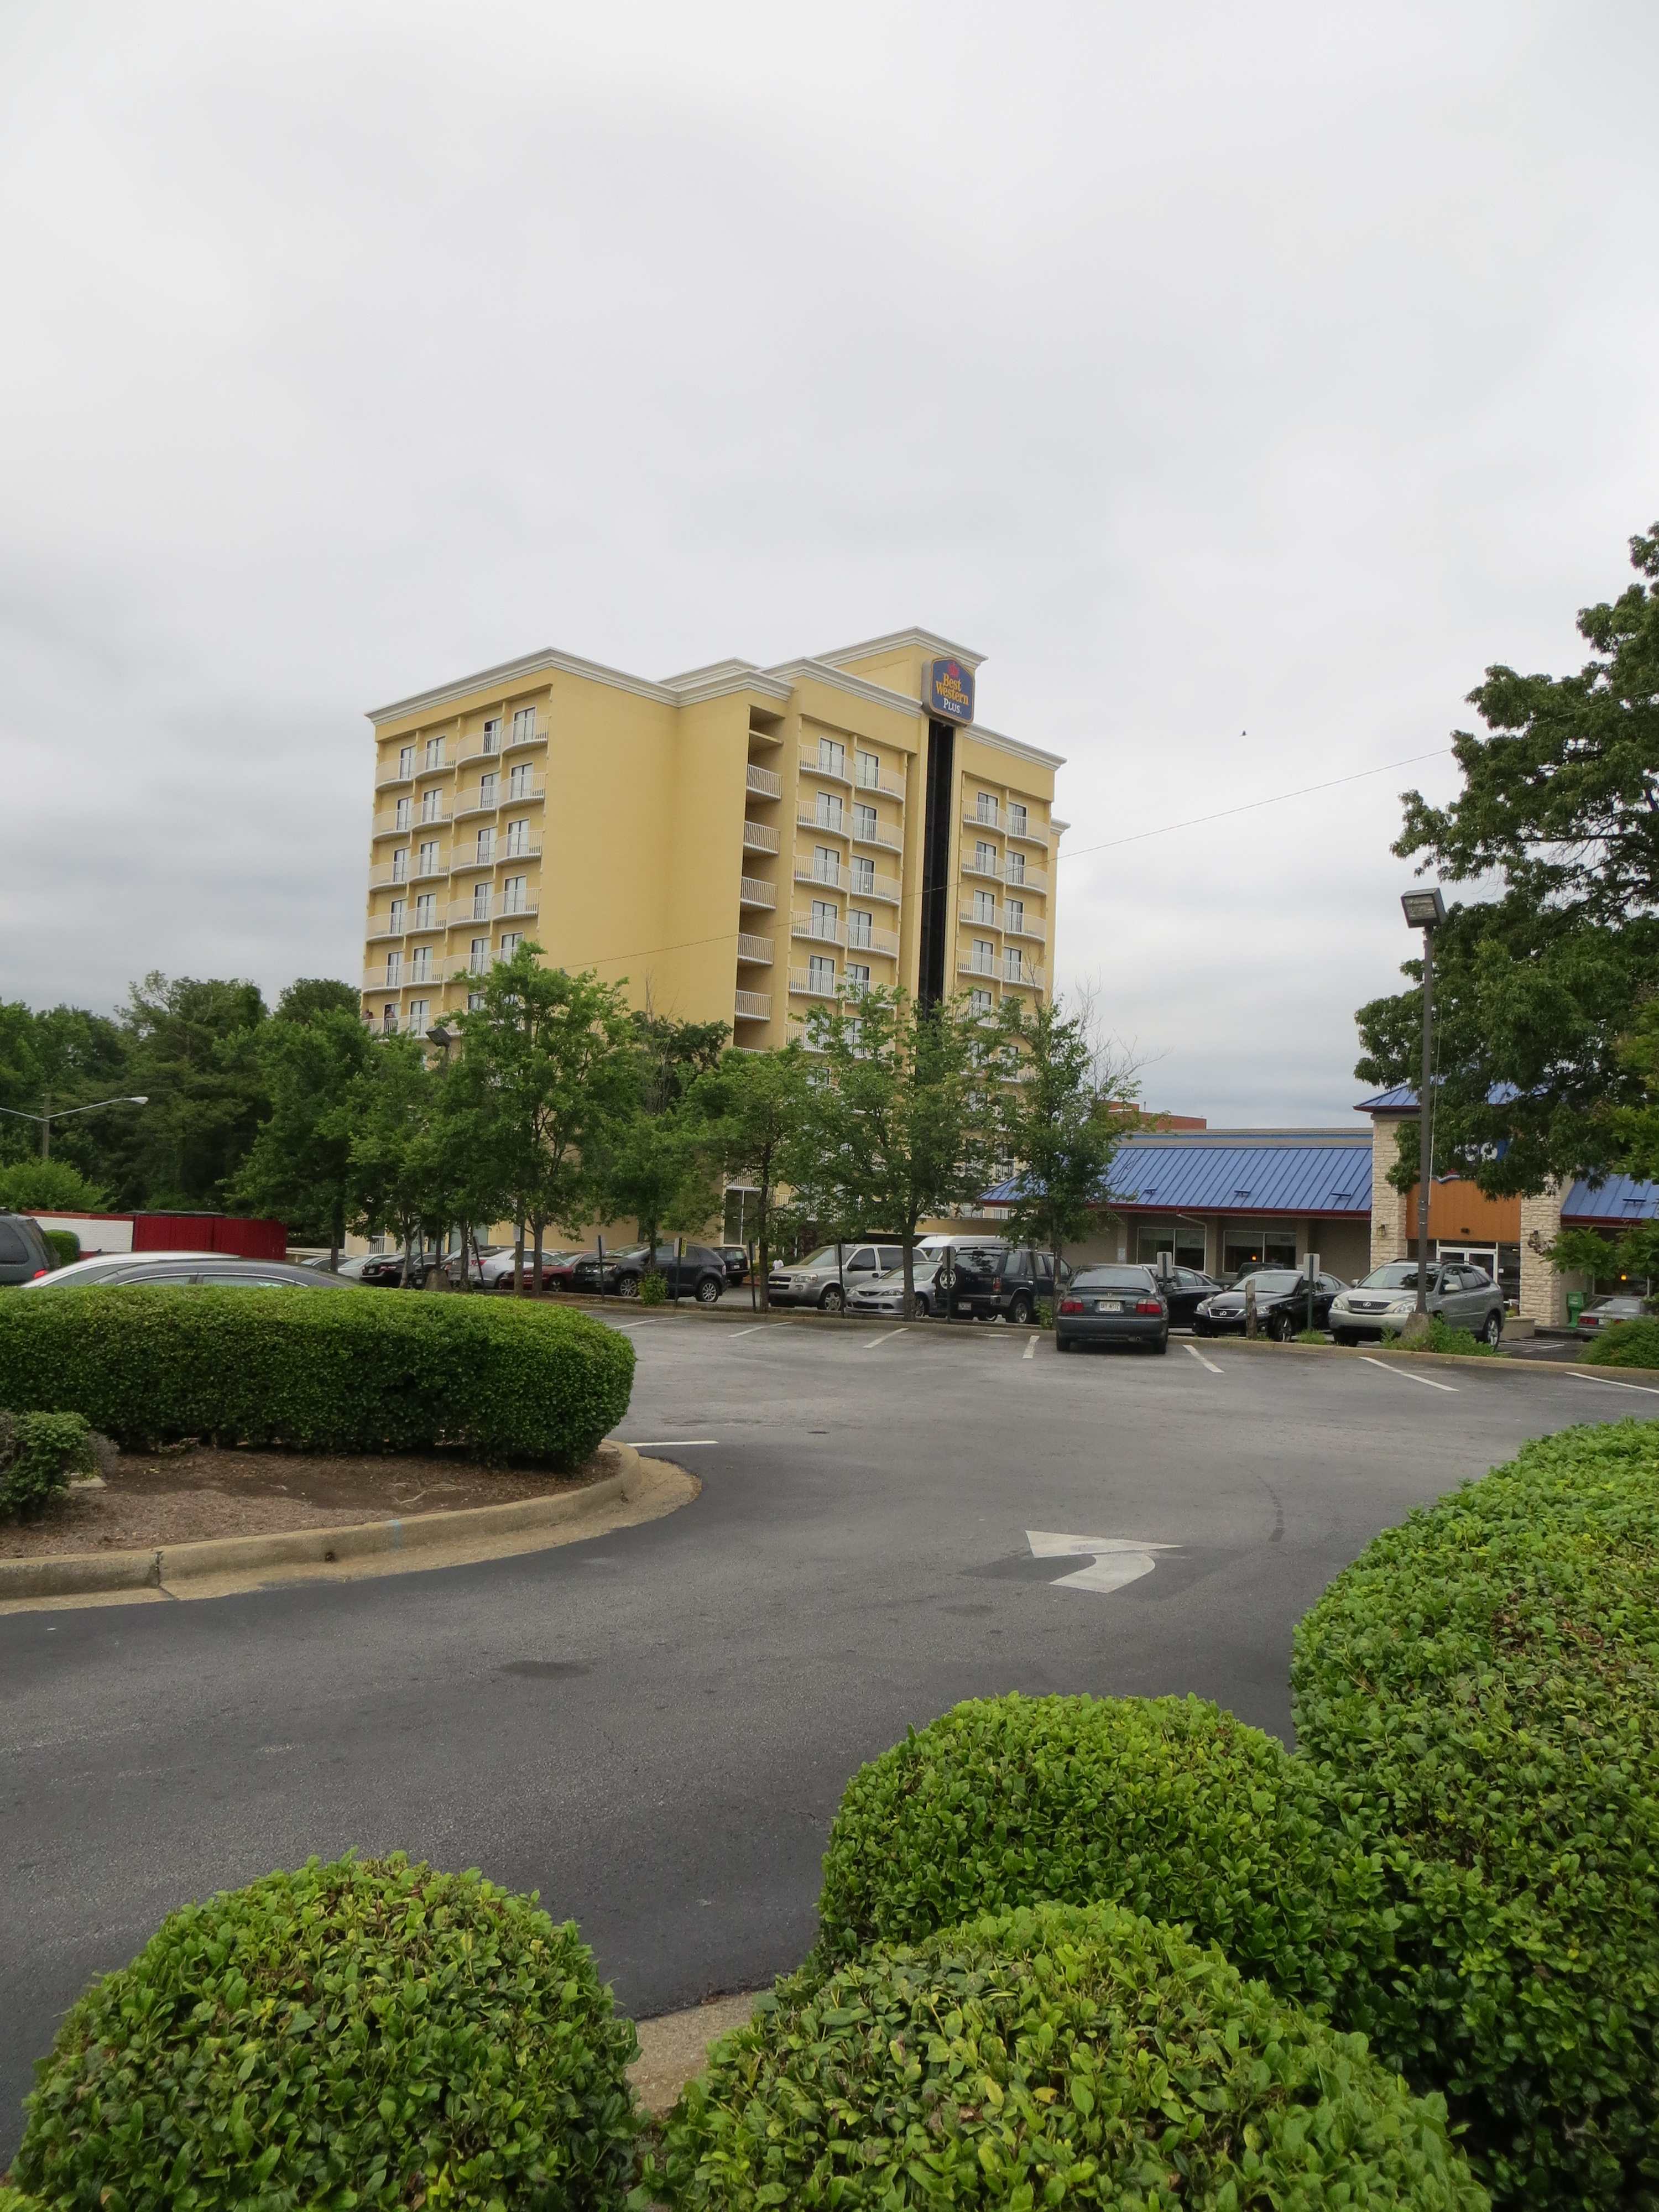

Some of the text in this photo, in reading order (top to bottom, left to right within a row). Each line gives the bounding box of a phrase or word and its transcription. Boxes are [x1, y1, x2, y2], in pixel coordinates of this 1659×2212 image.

[943, 672, 961, 691] Best
[936, 681, 969, 706] Western
[943, 697, 961, 713] PLUS
